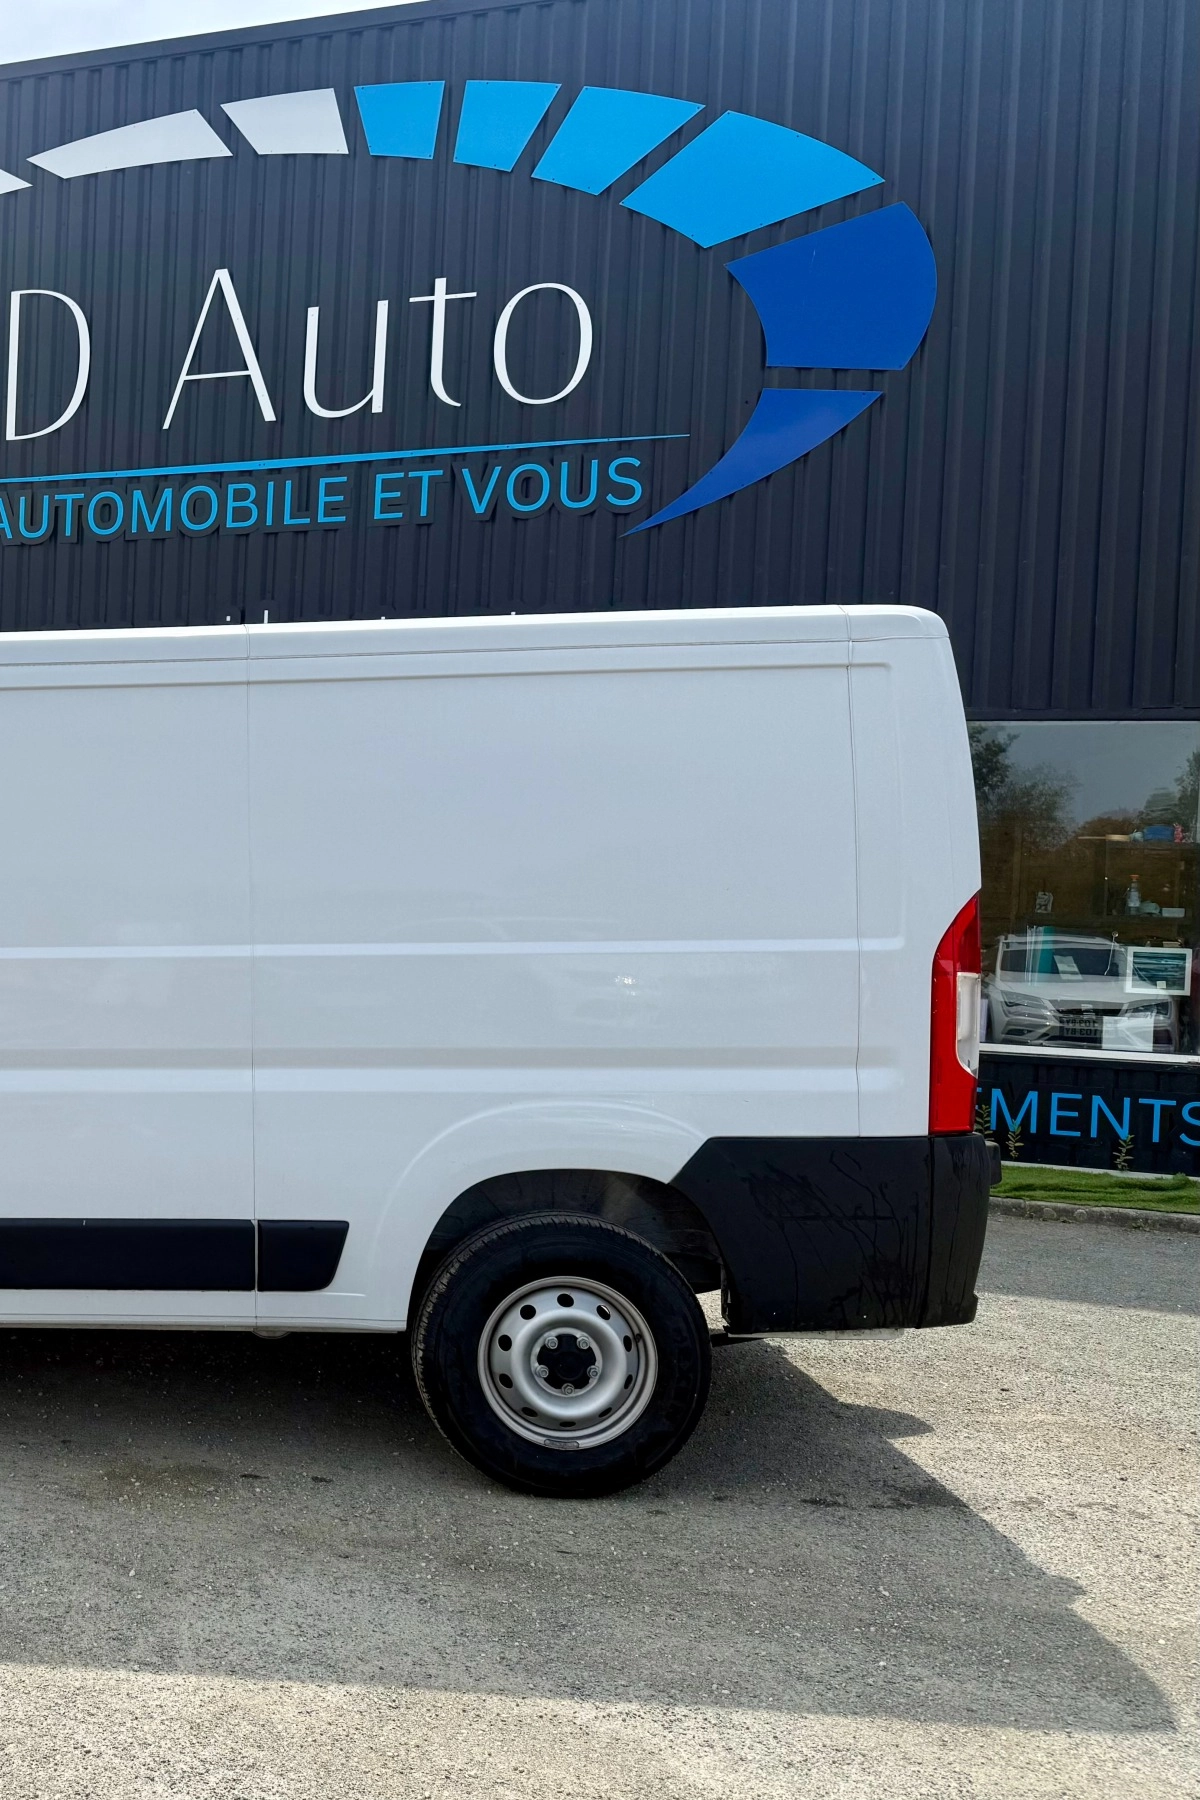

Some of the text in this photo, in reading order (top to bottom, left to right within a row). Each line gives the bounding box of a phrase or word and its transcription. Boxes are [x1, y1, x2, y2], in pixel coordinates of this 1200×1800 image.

[162, 268, 593, 430] Auto
[373, 469, 444, 520] ET
[461, 456, 643, 514] VOUS
[976, 1087, 1200, 1147] MENTS
